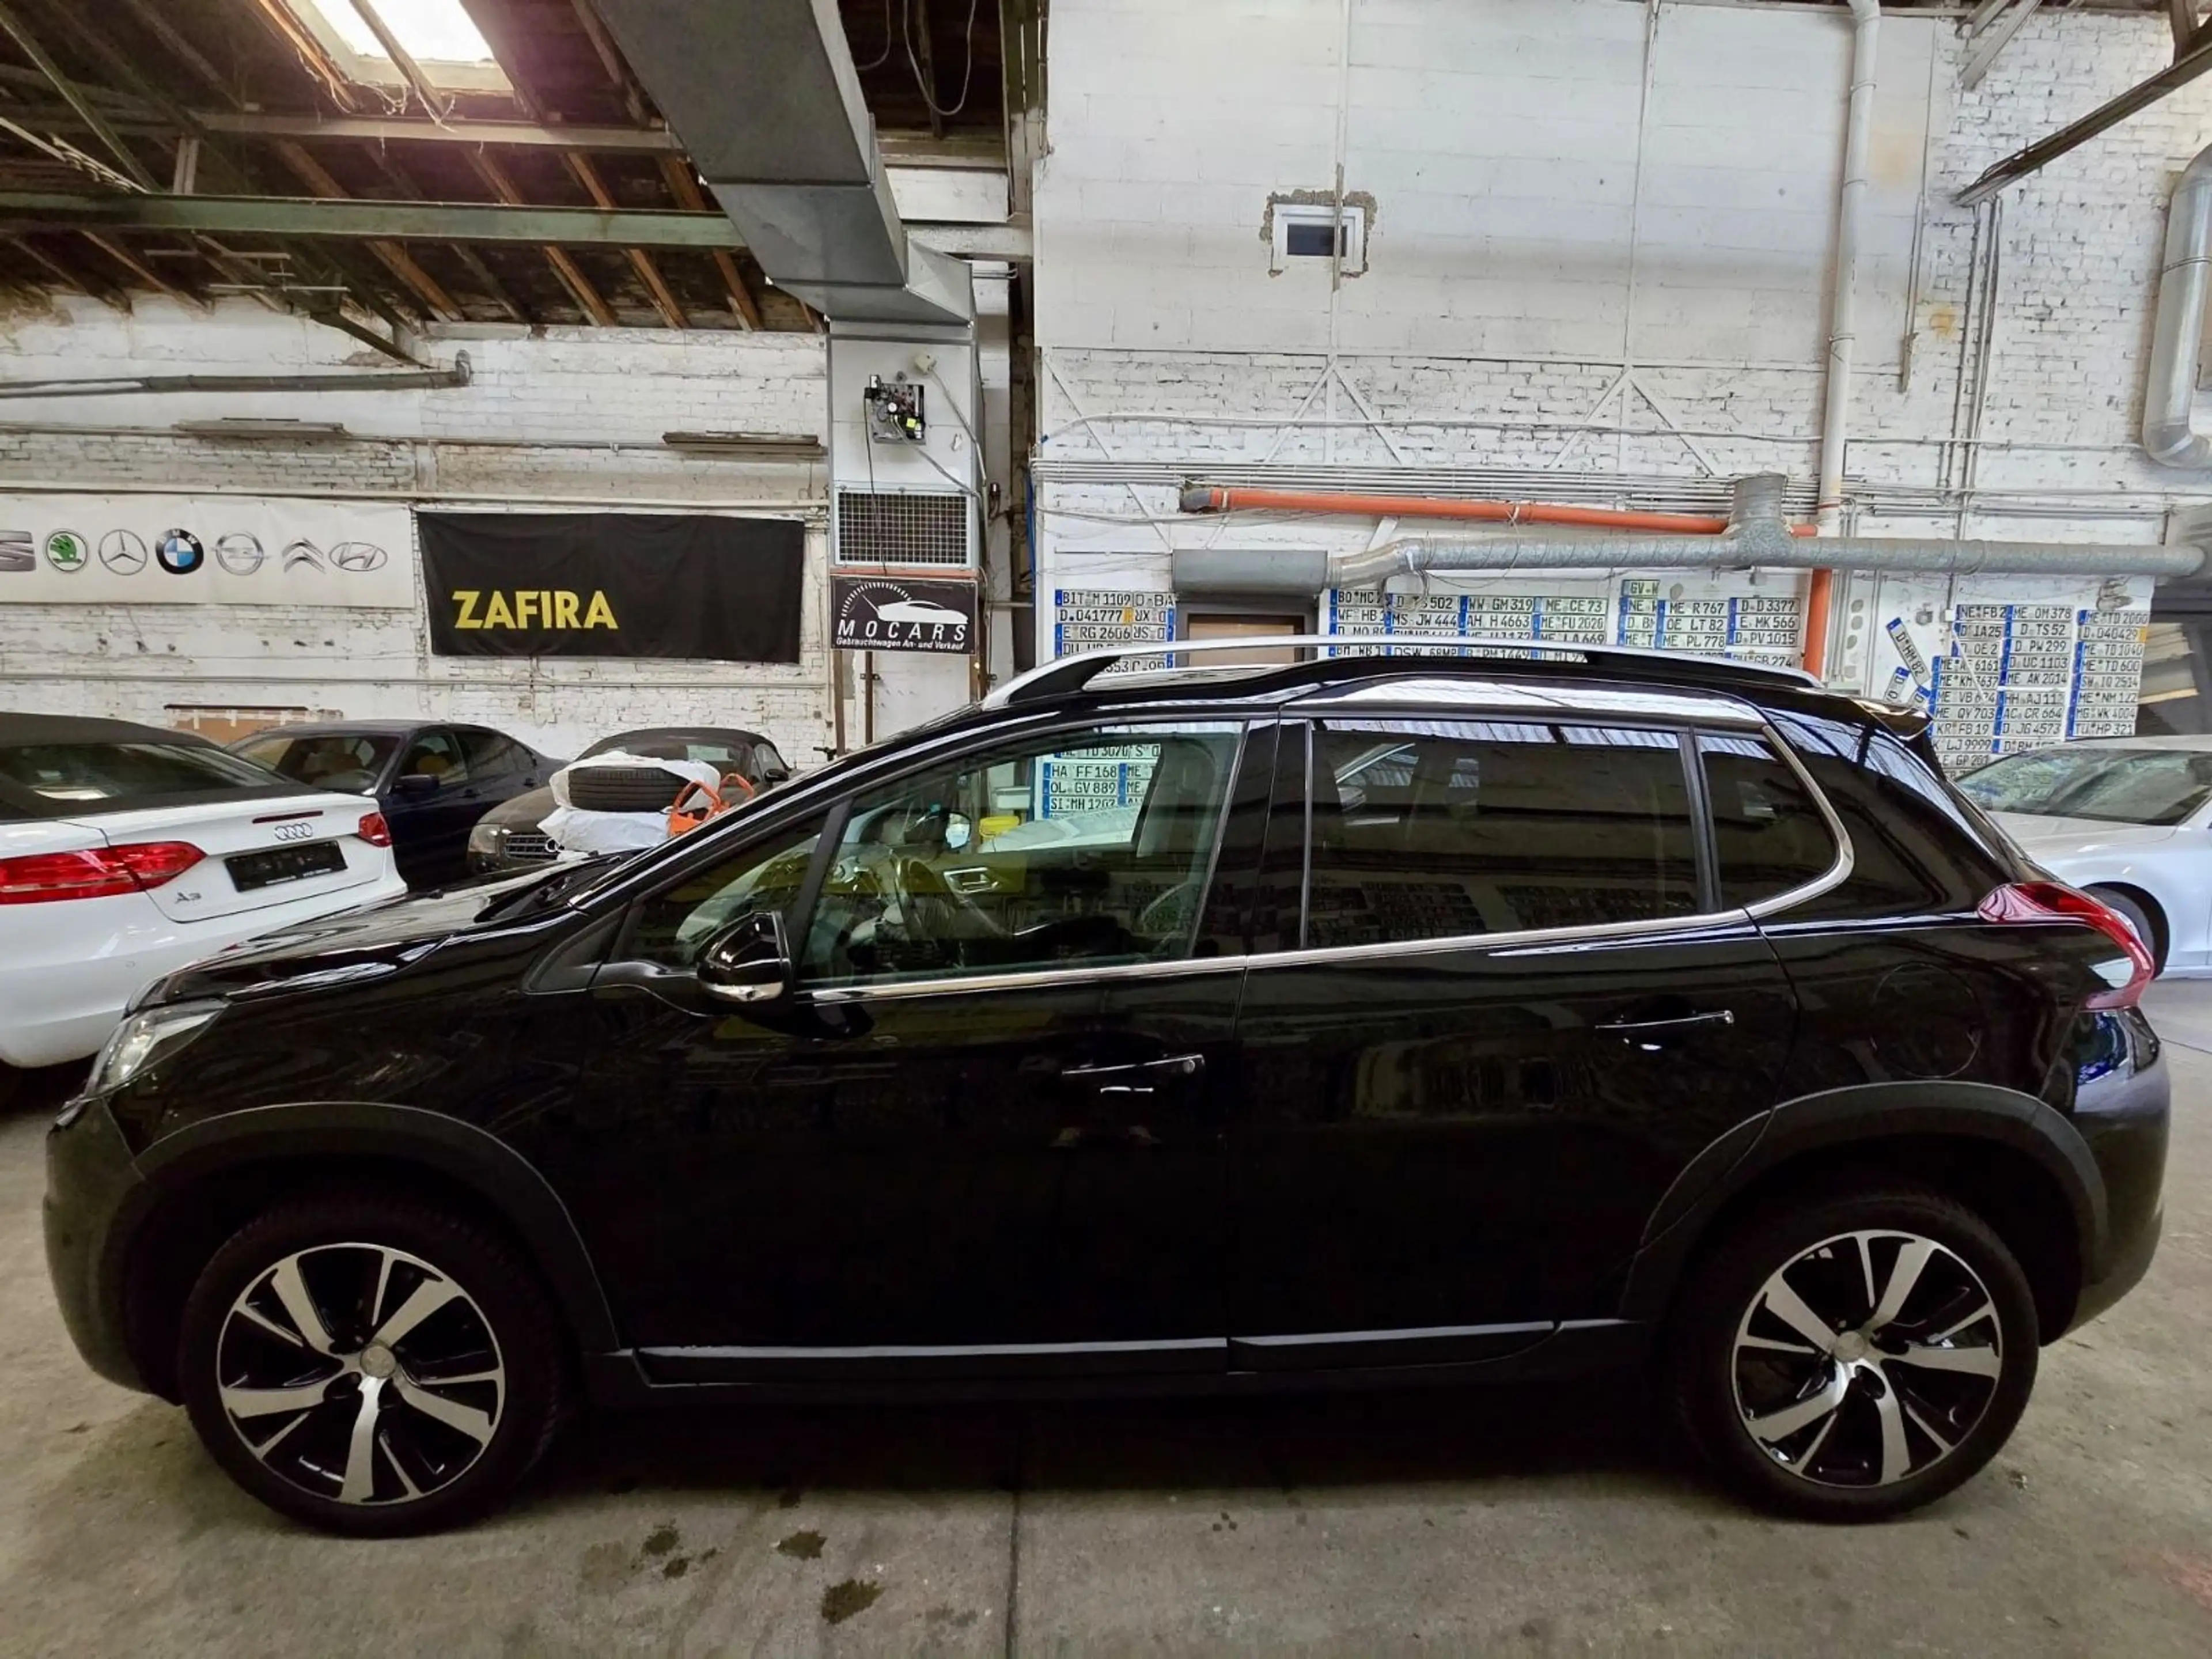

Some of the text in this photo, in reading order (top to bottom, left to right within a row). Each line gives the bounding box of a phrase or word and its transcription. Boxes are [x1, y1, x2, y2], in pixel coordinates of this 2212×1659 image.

[1063, 592, 1084, 605] BIT
[1338, 592, 1351, 604] BO
[1430, 597, 1452, 609] 502
[452, 590, 619, 630] ZAFIRA
[1703, 602, 1725, 615] 767
[1766, 600, 1794, 612] 3377
[1435, 614, 1457, 627] 444
[1501, 615, 1529, 627] 4663
[1740, 616, 1748, 628] E
[1772, 616, 1796, 628] 566
[1064, 626, 1071, 639] E
[1767, 632, 1796, 645] 1015
[2046, 640, 2067, 652] 299
[1052, 765, 1117, 778] HA FF 168
[1050, 782, 1116, 794] OL GV 889
[1051, 798, 1063, 809] SI
